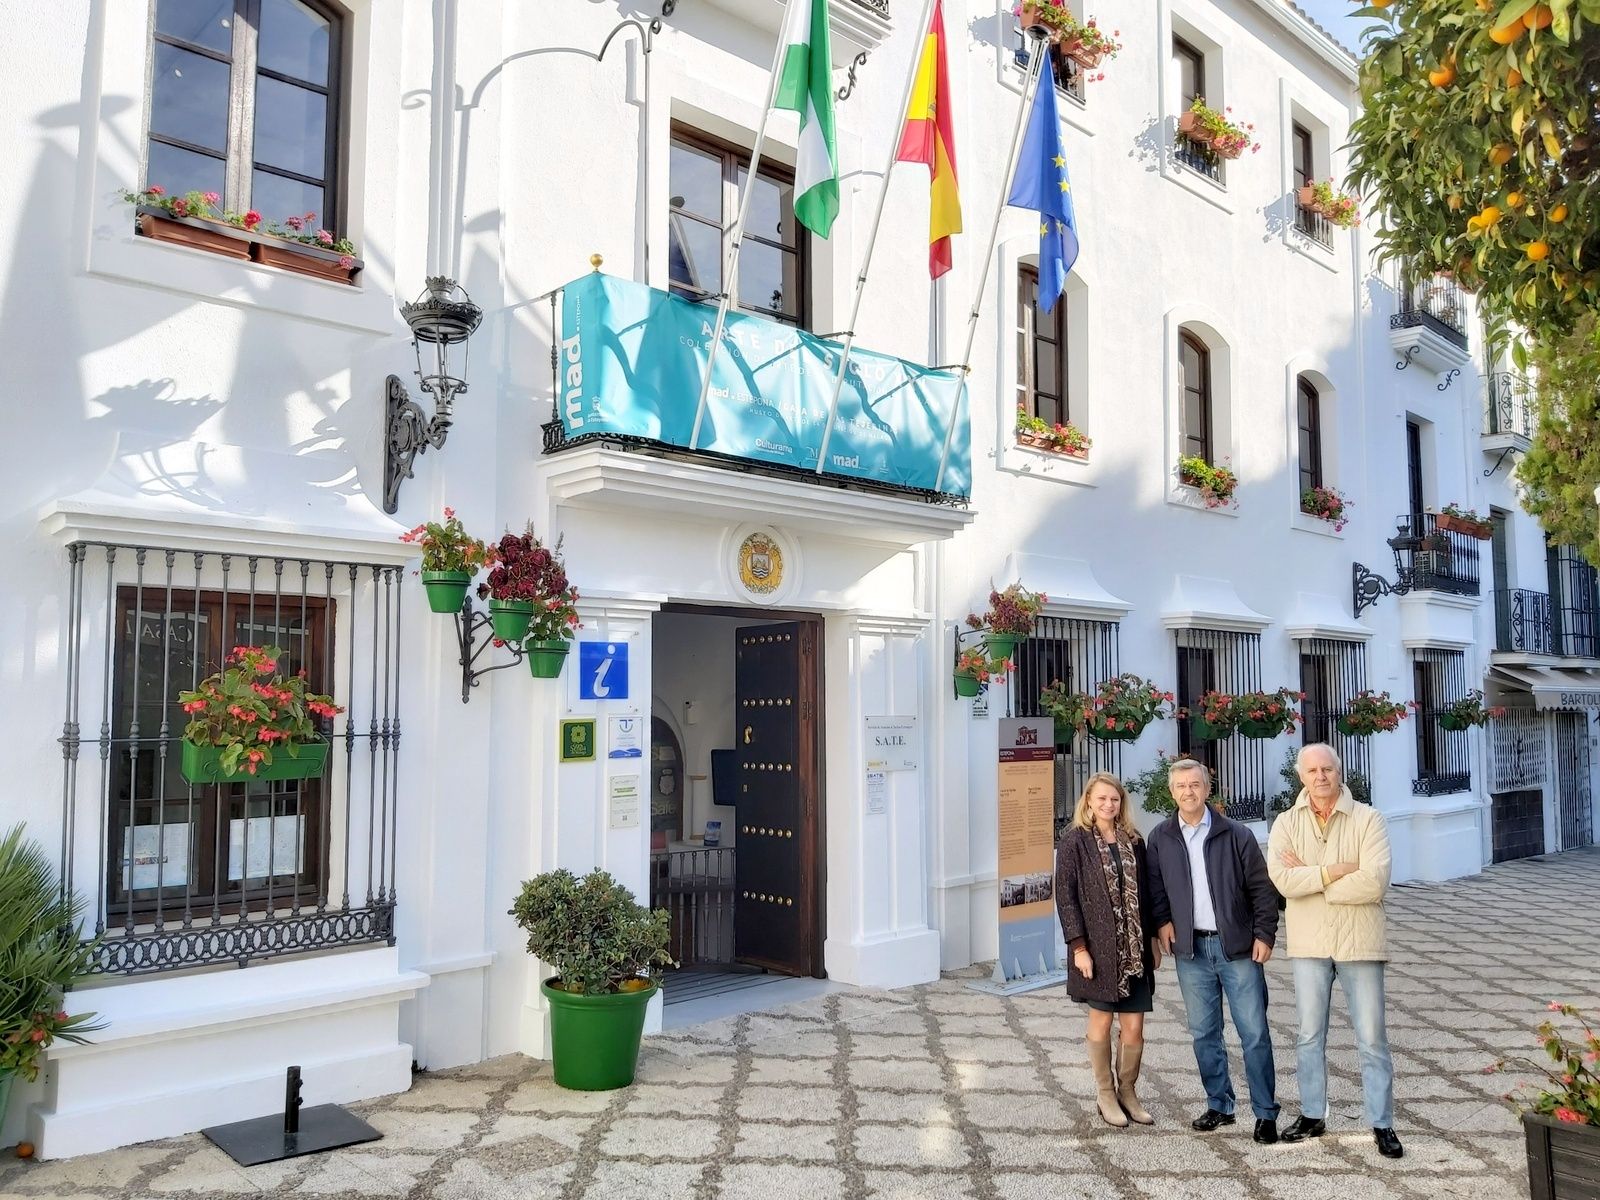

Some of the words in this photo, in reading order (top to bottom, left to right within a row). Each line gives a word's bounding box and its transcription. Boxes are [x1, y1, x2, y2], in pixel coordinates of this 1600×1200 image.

[562, 333, 584, 430] mad
[755, 438, 793, 454] Culturama
[1560, 692, 1600, 706] BARTOL
[874, 735, 907, 746] S.A.T.E.
